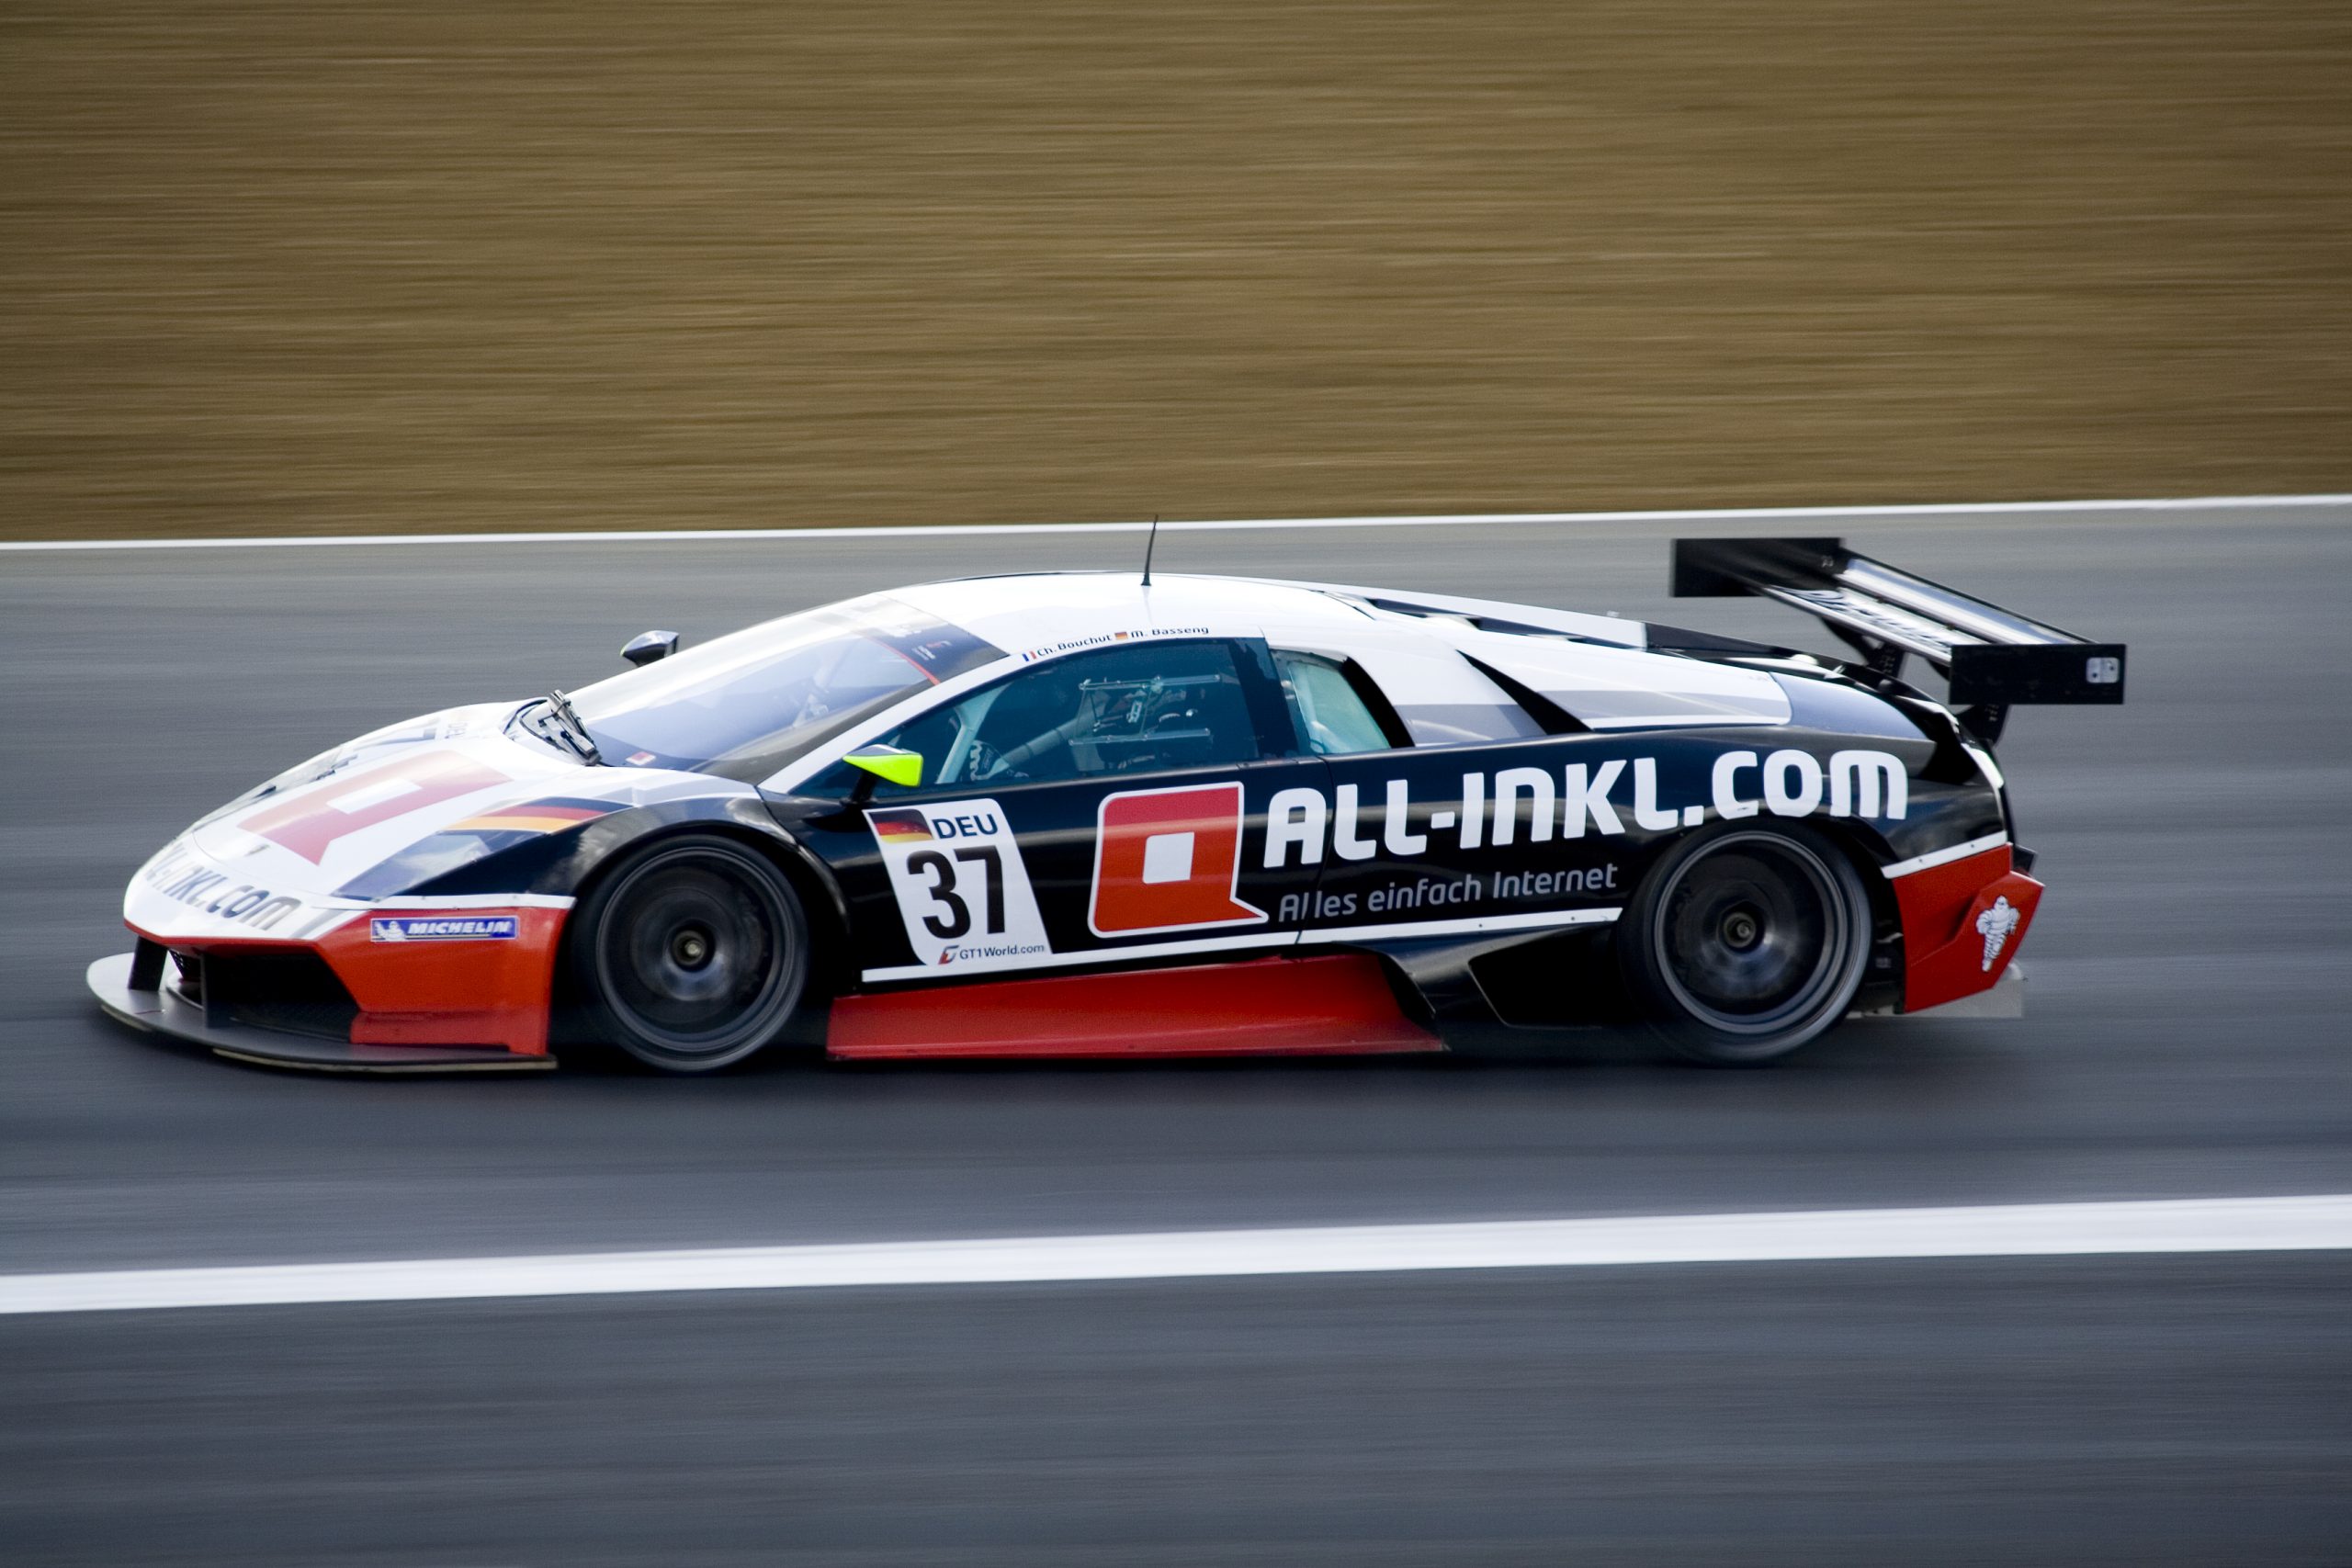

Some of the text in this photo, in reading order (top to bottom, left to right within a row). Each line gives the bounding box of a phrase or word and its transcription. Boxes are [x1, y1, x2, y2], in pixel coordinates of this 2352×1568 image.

[1152, 626, 1209, 636] Basseng
[932, 814, 999, 840] DEU
[1263, 750, 1908, 868] ALL-INKL.COM
[906, 845, 1005, 939] 37
[1279, 863, 1618, 922] Alles einfach Internet
[407, 921, 511, 934] MICHELIN
